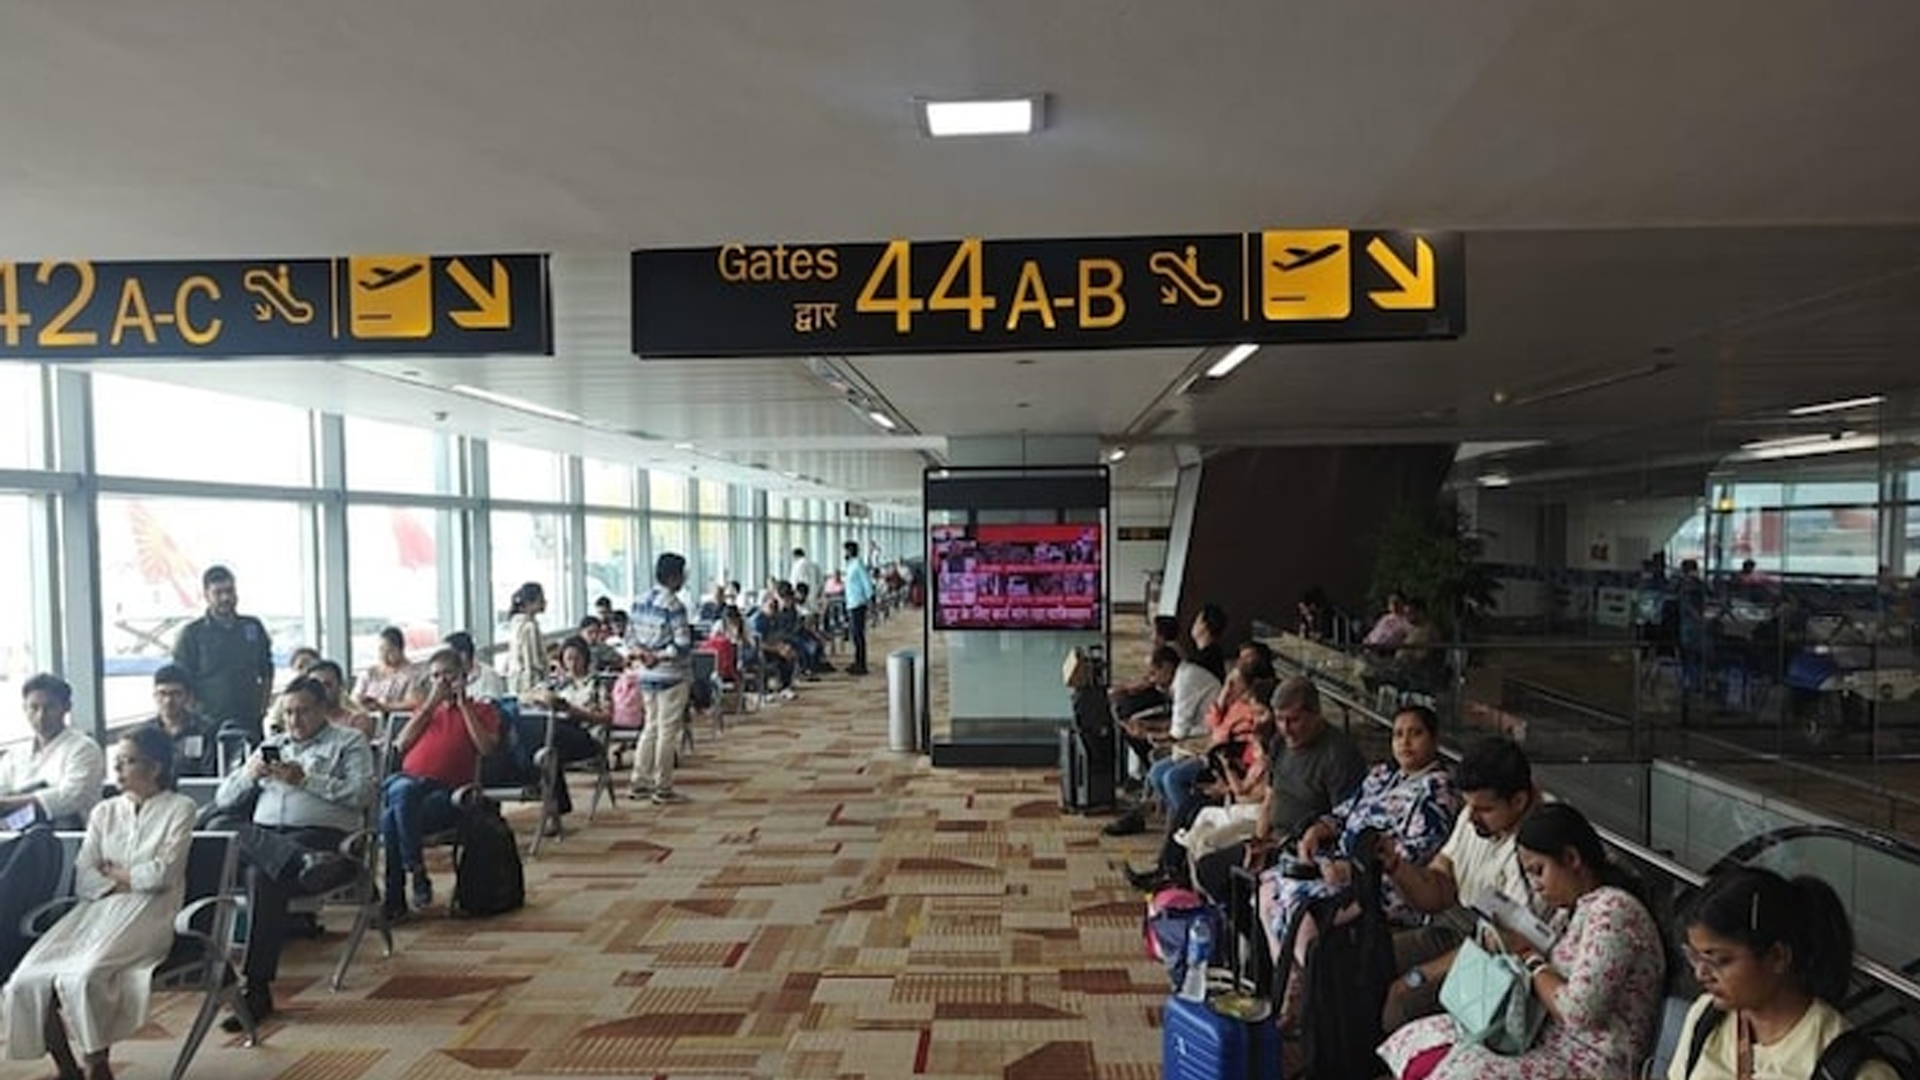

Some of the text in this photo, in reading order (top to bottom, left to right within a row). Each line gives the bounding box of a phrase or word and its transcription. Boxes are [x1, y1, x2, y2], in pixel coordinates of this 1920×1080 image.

[110, 275, 222, 345] A-C
[718, 237, 1126, 333] Gates 44 A-B
[793, 302, 839, 332] द्वार
